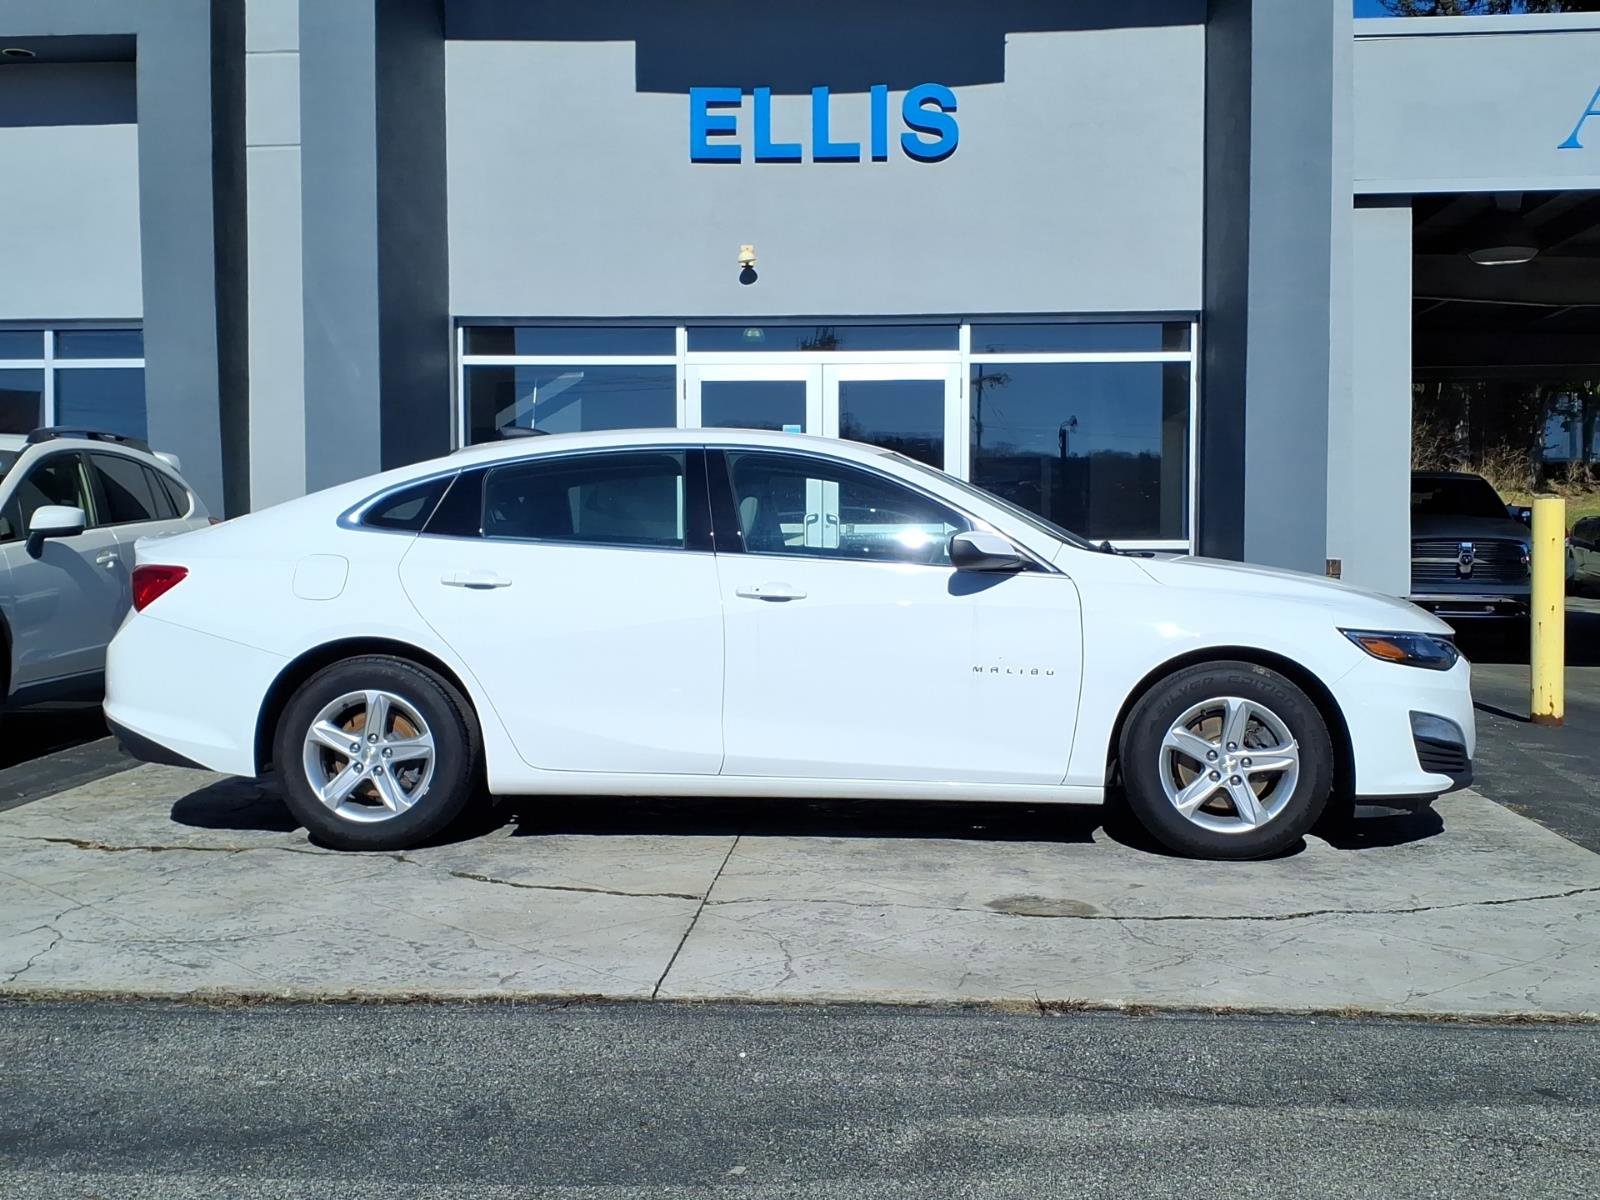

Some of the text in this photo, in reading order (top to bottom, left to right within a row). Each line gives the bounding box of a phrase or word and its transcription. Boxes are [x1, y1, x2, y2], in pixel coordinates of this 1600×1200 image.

[689, 83, 959, 163] ELLIS
[972, 665, 1055, 676] MALIBU
[1227, 674, 1297, 709] EDITION
